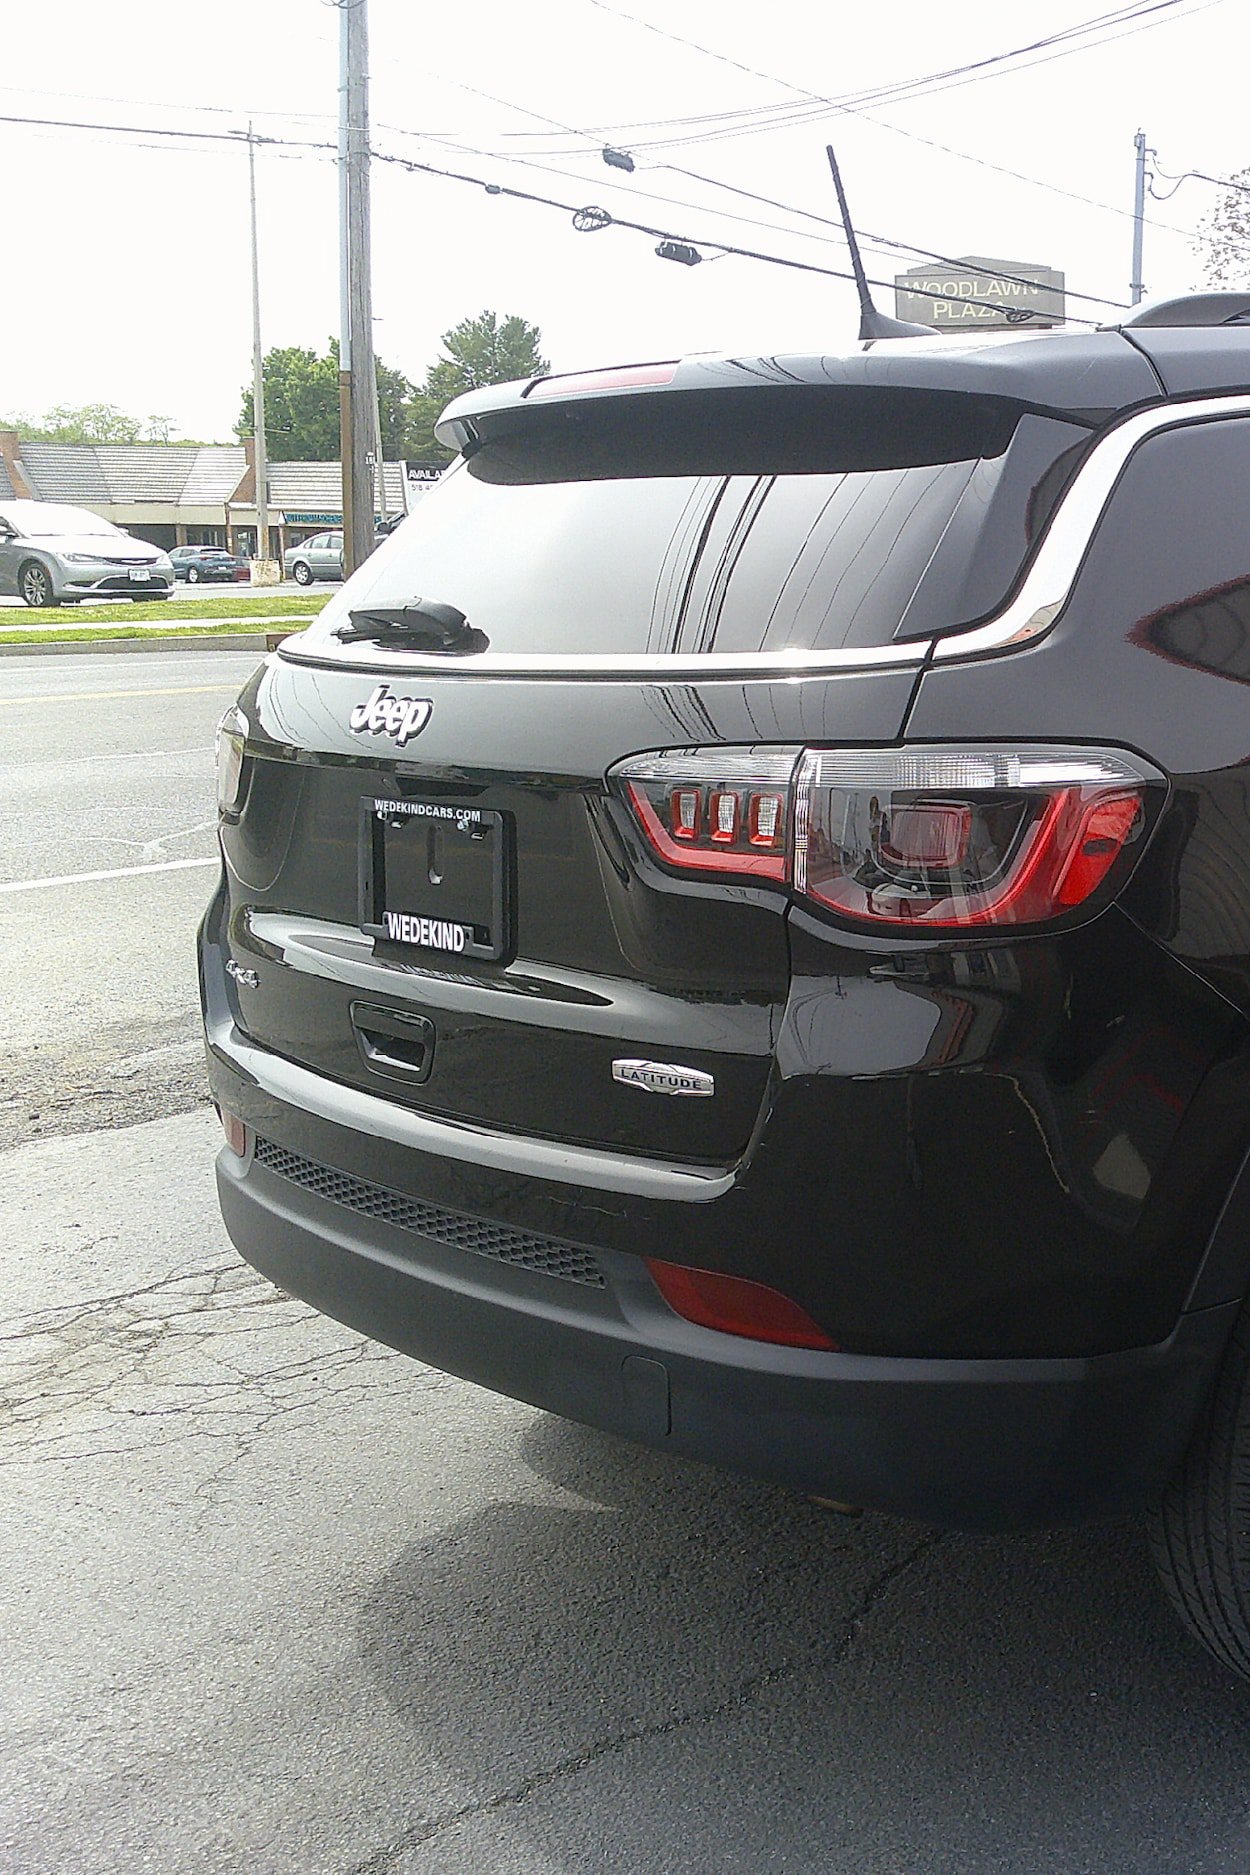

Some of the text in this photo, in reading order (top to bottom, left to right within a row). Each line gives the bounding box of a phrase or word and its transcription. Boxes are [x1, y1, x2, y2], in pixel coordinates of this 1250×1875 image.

[904, 279, 1039, 299] WOODLAWN
[933, 302, 1008, 320] PLAZA
[349, 684, 434, 748] Jeep
[374, 799, 482, 823] WEDEKINDCARS.COM
[387, 911, 466, 953] WEDEKIND
[620, 1068, 702, 1089] LATITUDE
